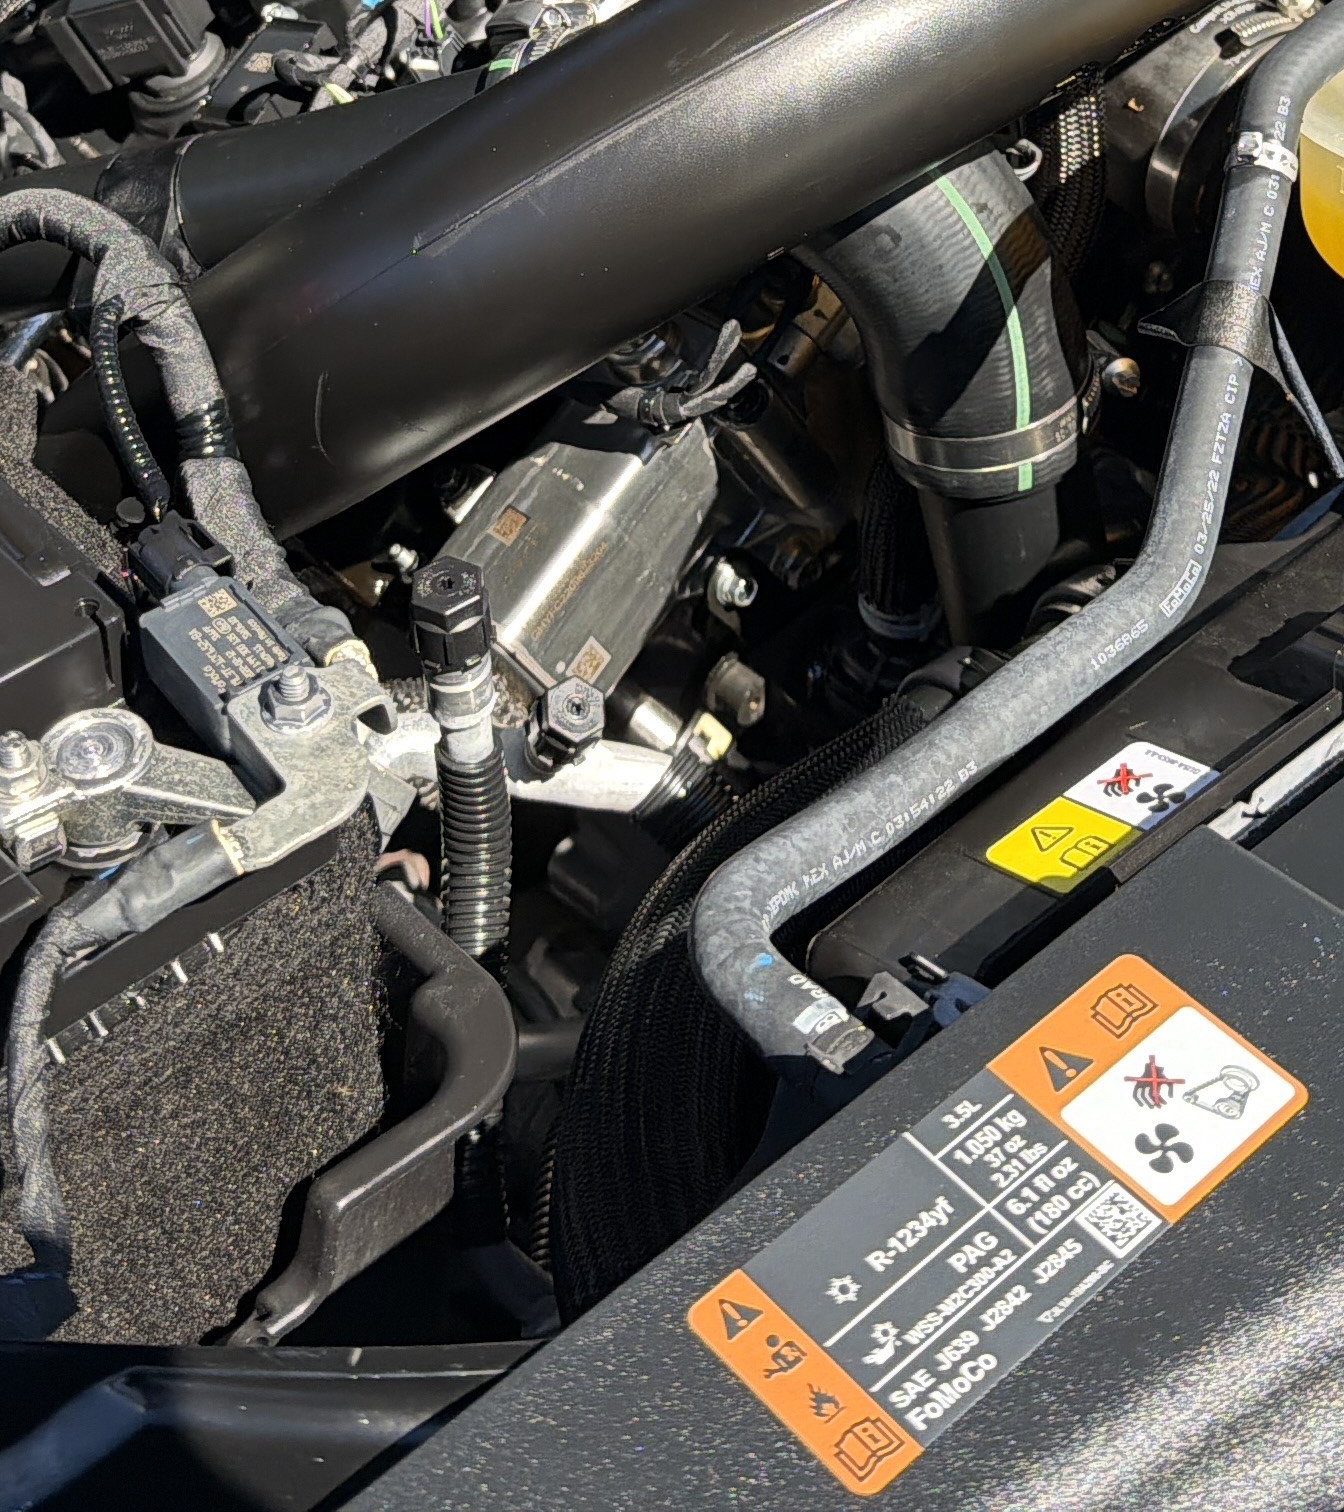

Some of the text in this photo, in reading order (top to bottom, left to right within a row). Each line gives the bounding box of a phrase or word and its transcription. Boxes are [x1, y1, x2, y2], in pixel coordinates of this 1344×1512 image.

[1194, 469, 1221, 555] 03/25/22
[941, 1100, 982, 1129] 3.5L
[954, 1109, 1027, 1165] 1.050 kg
[982, 1134, 1027, 1168] 37 oz
[1018, 1142, 1048, 1165] lbs
[1005, 1156, 1079, 1215] 6.1 fl oz
[1026, 1170, 1101, 1235] (180 cc)
[865, 1196, 953, 1272] R-1234yf
[946, 1231, 998, 1273] PAG
[889, 1369, 936, 1408] SAE
[935, 1330, 979, 1371] J639
[905, 1354, 997, 1430] FoMoCo
